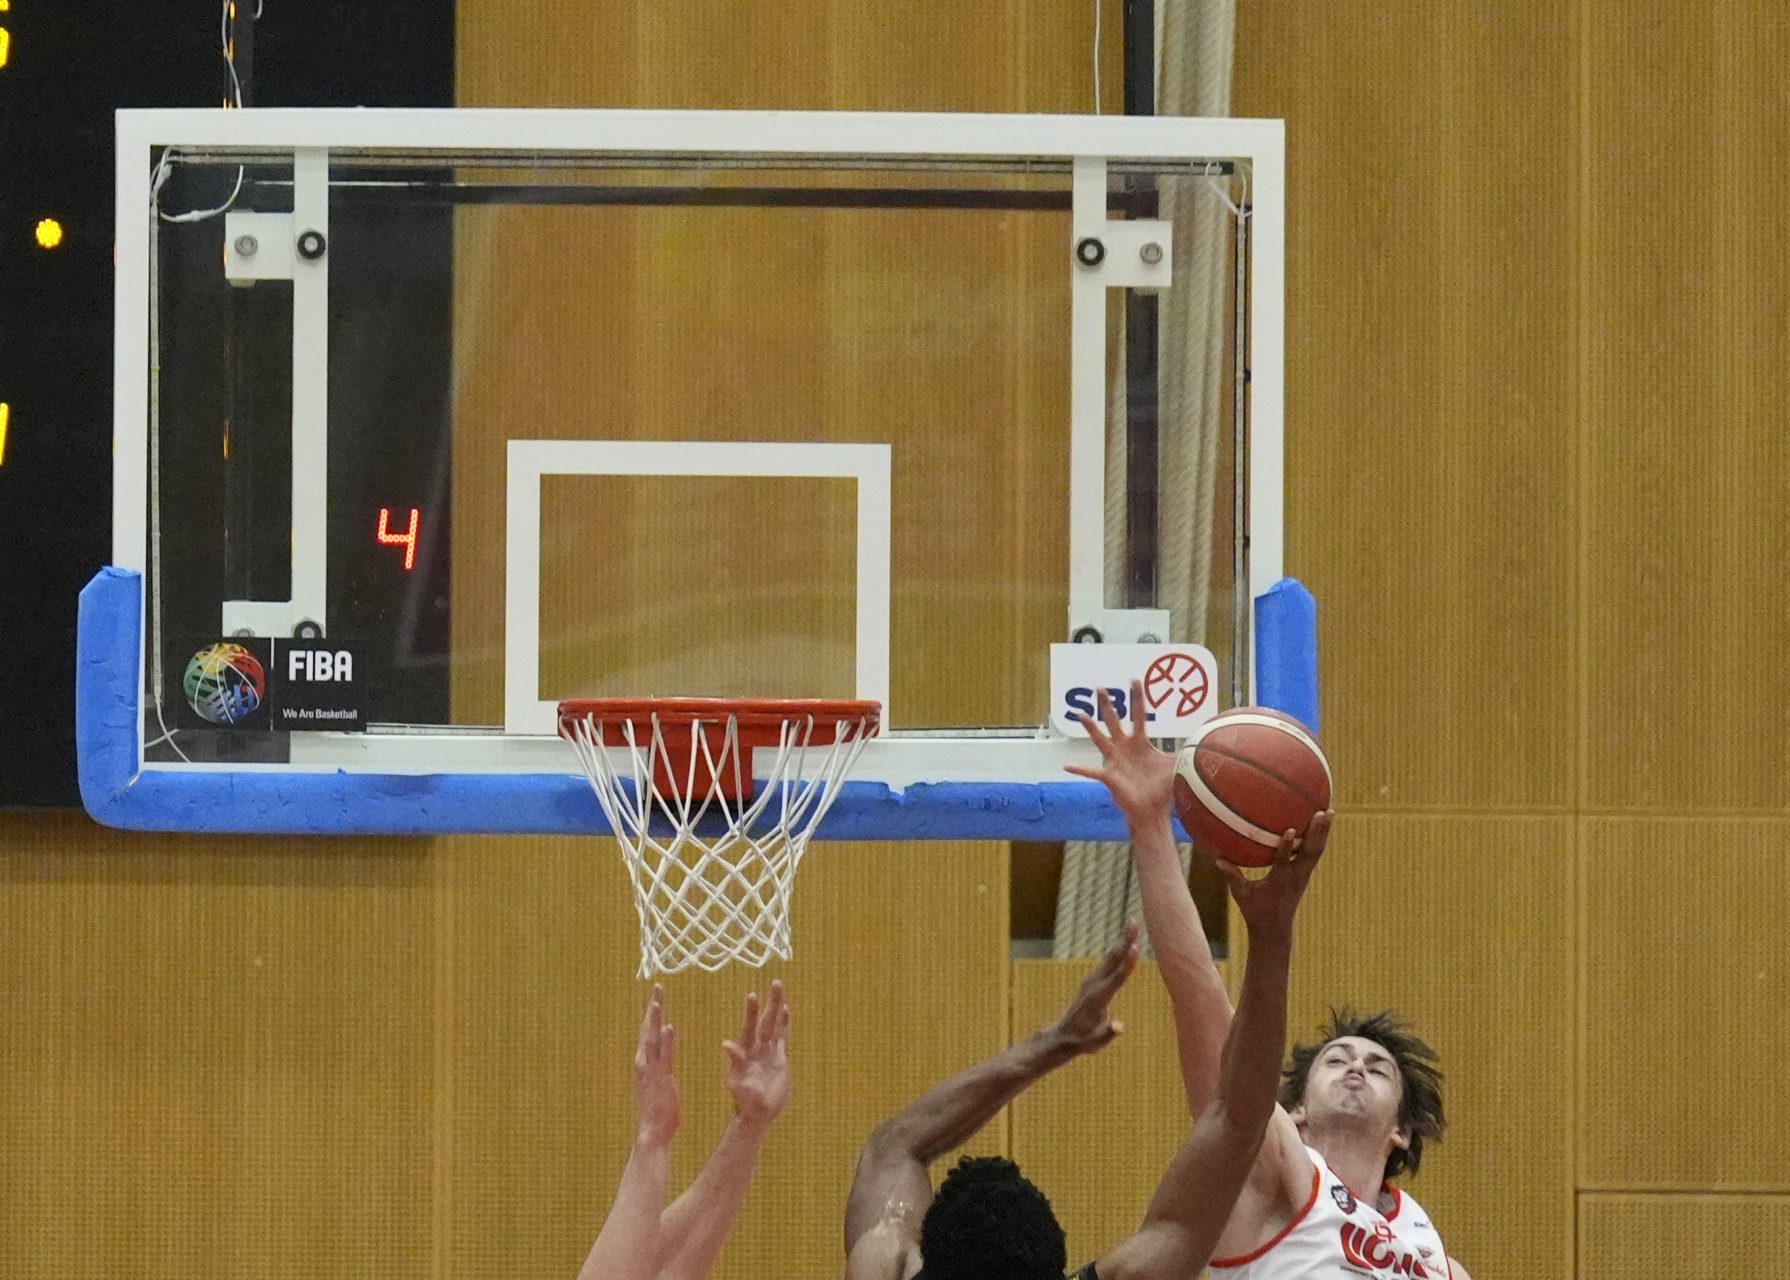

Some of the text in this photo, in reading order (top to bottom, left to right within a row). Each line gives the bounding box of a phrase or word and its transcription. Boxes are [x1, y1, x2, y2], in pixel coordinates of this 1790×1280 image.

[378, 508, 419, 569] 4
[288, 650, 353, 682] FIBA
[283, 708, 358, 720] We Are Basketball
[1064, 686, 1156, 722] SBL
